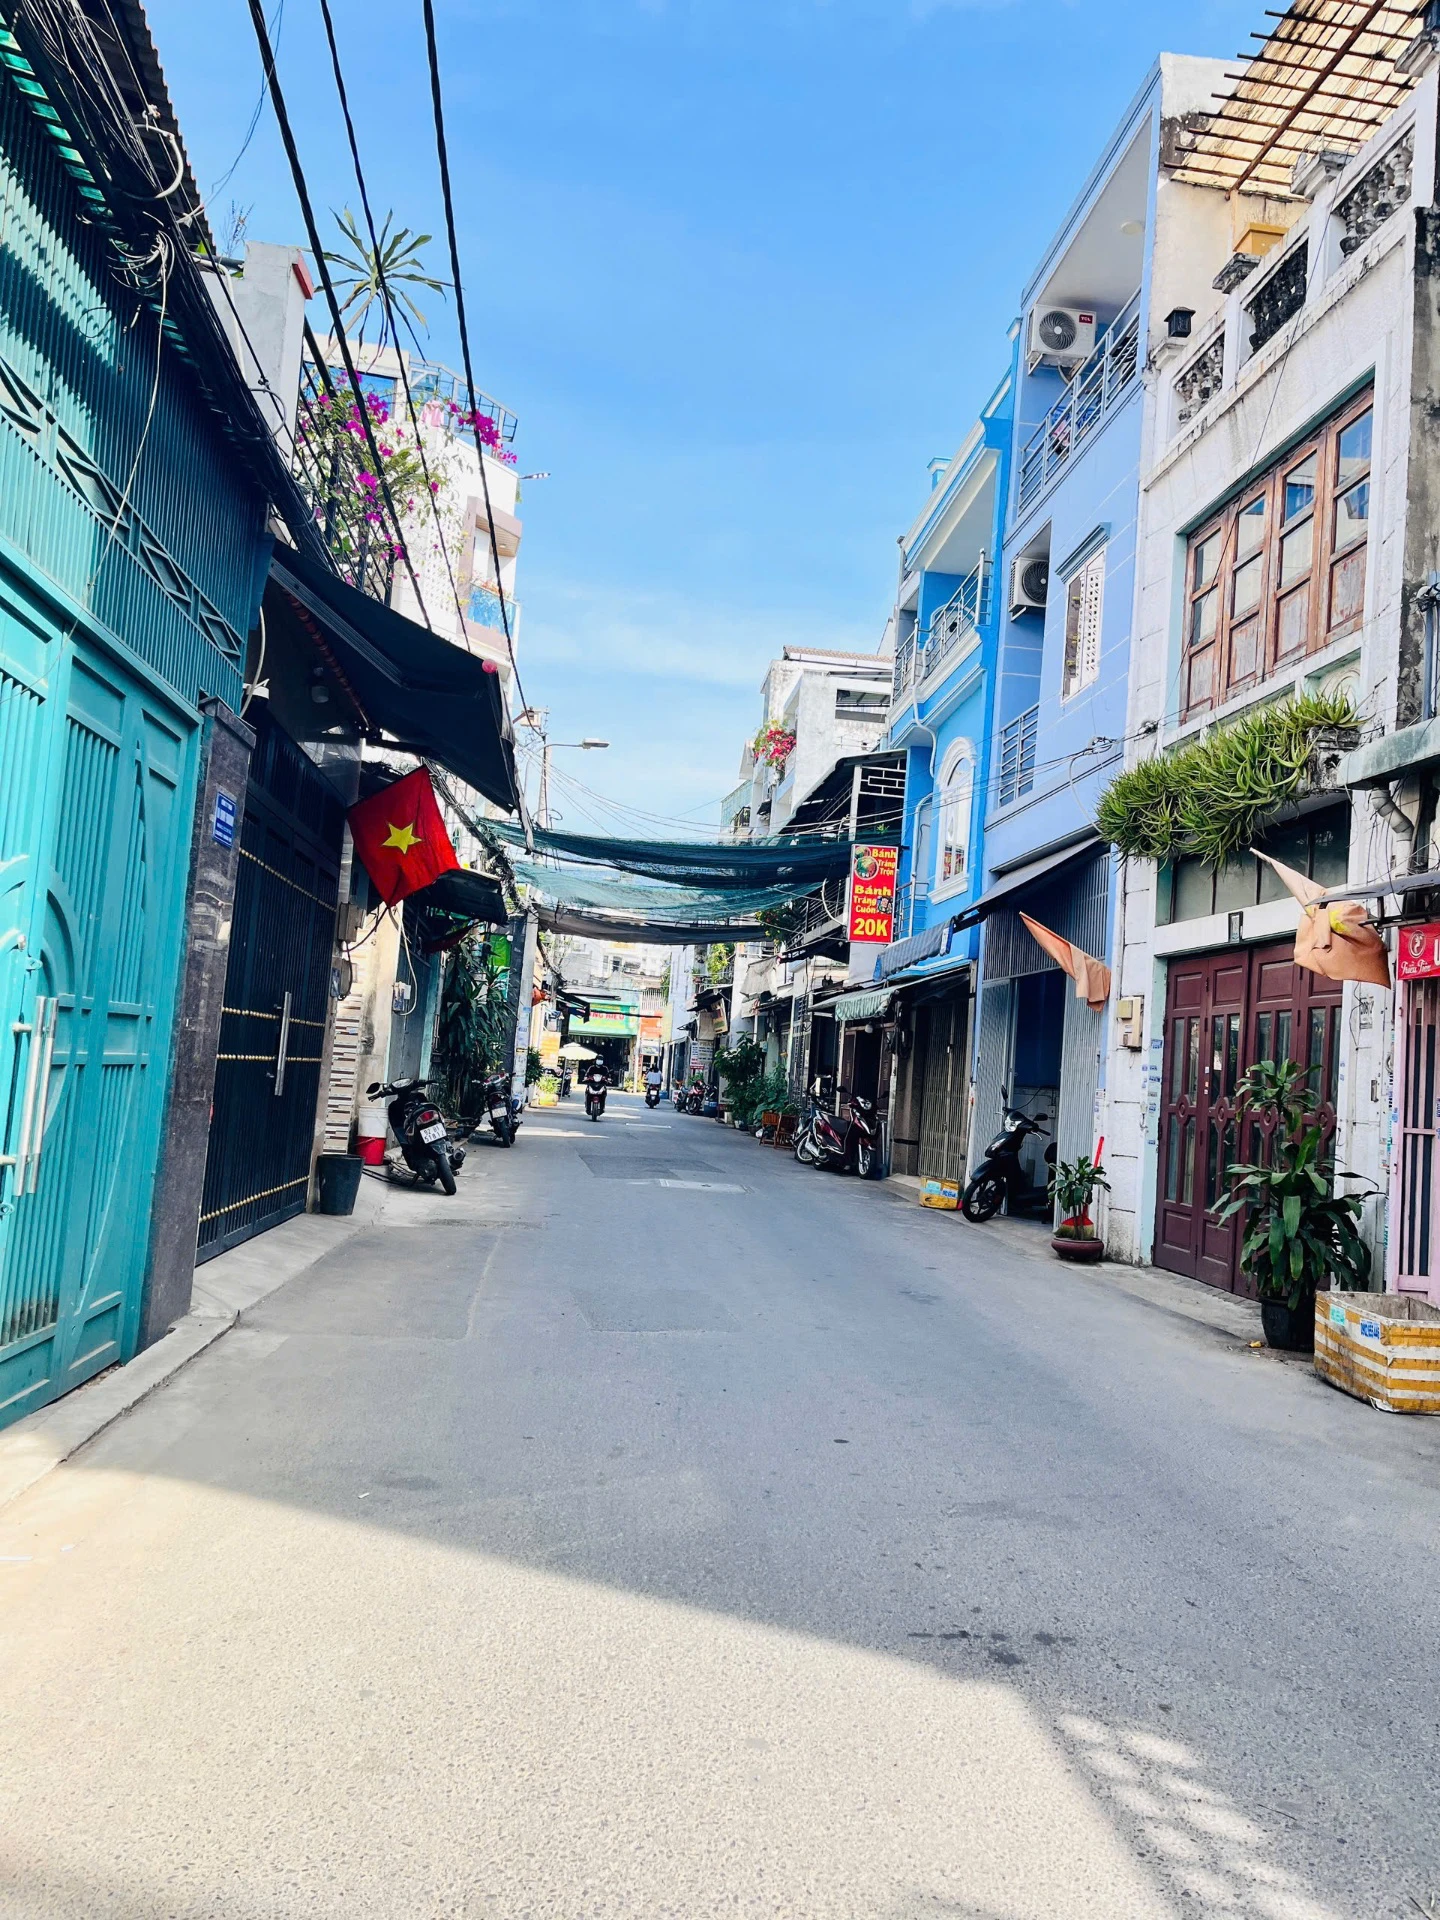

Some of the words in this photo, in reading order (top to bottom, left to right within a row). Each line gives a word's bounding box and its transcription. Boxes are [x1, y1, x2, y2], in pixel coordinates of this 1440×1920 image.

[872, 848, 896, 858] Bánh
[854, 885, 891, 896] Bánh
[853, 917, 889, 937] 20K
